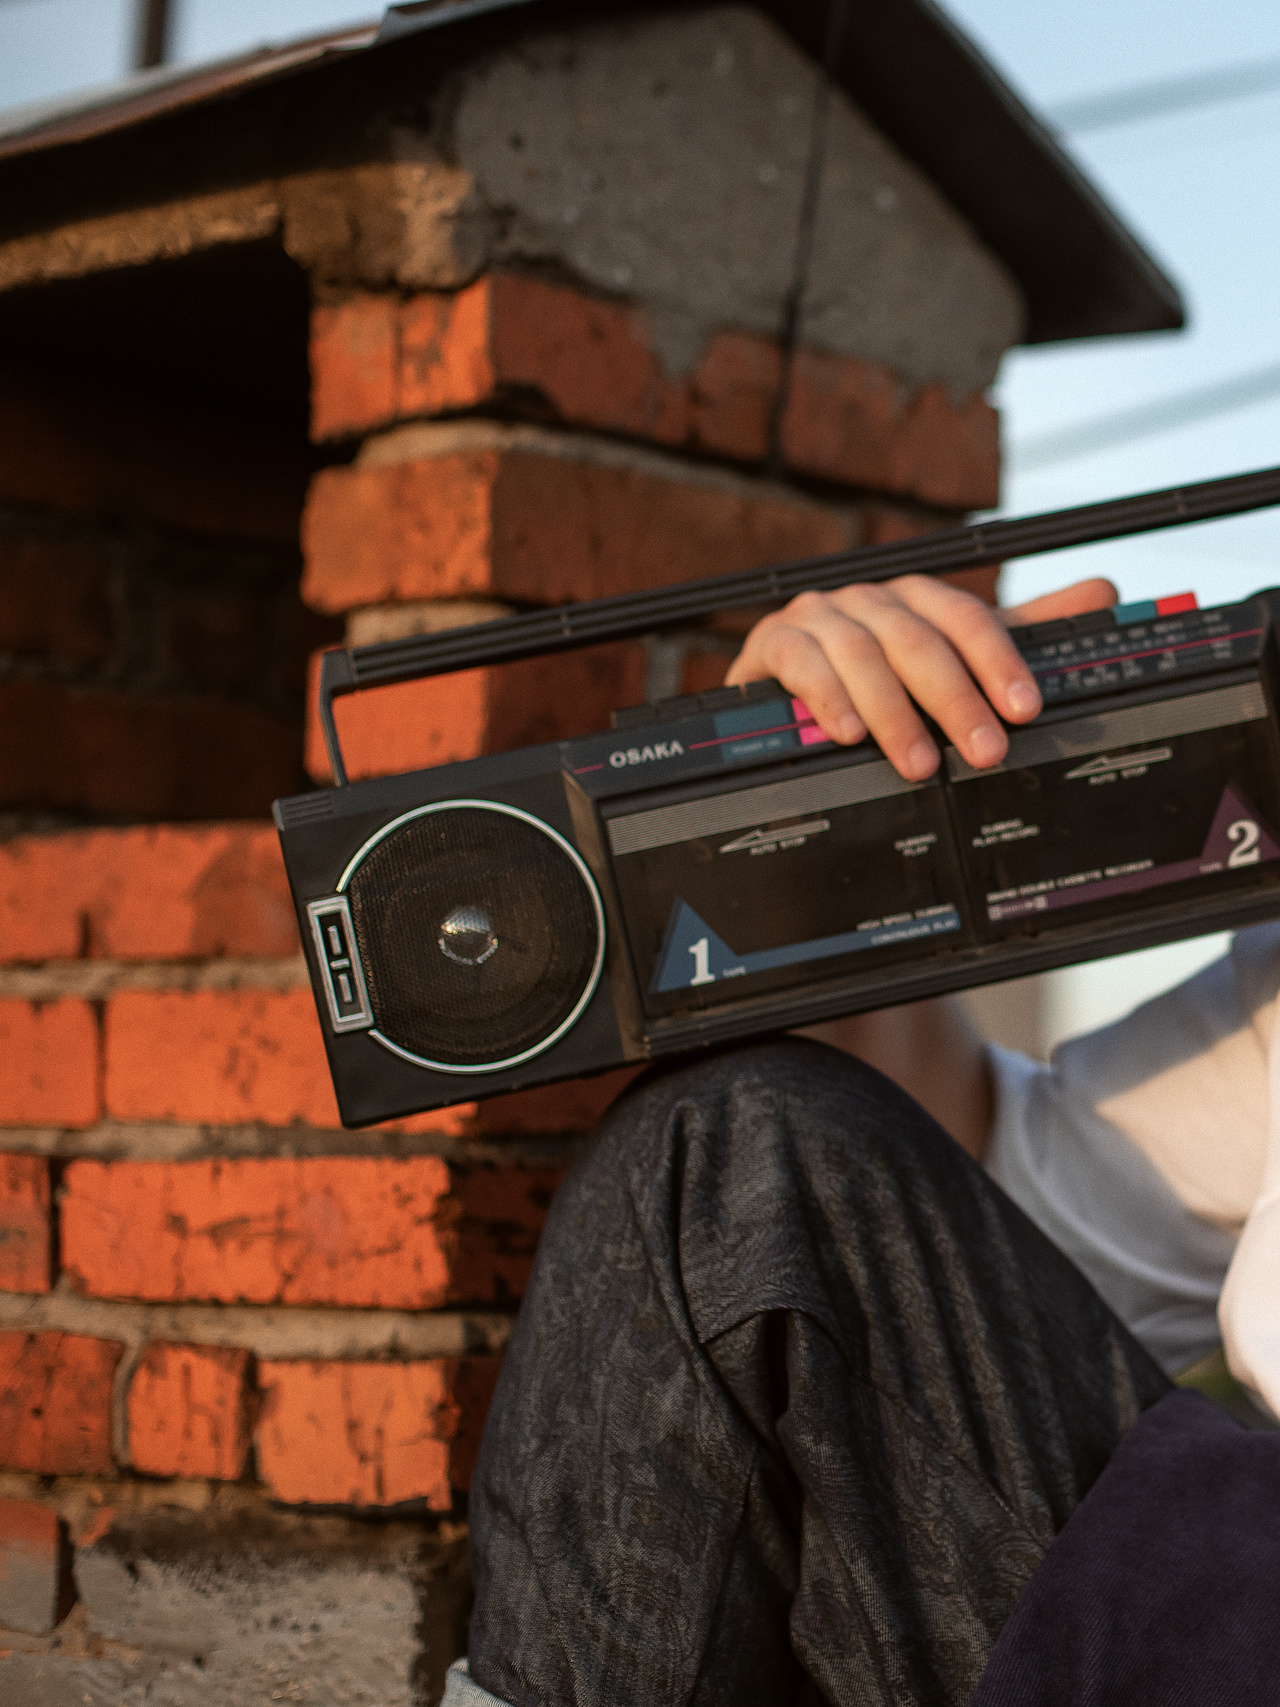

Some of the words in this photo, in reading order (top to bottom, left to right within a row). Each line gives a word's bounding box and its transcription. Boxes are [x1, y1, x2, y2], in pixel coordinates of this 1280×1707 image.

[609, 740, 684, 768] OSAKA
[1121, 765, 1148, 777] STOP
[750, 843, 776, 855] AUTO
[1227, 819, 1261, 868] 2
[689, 937, 716, 986] 1
